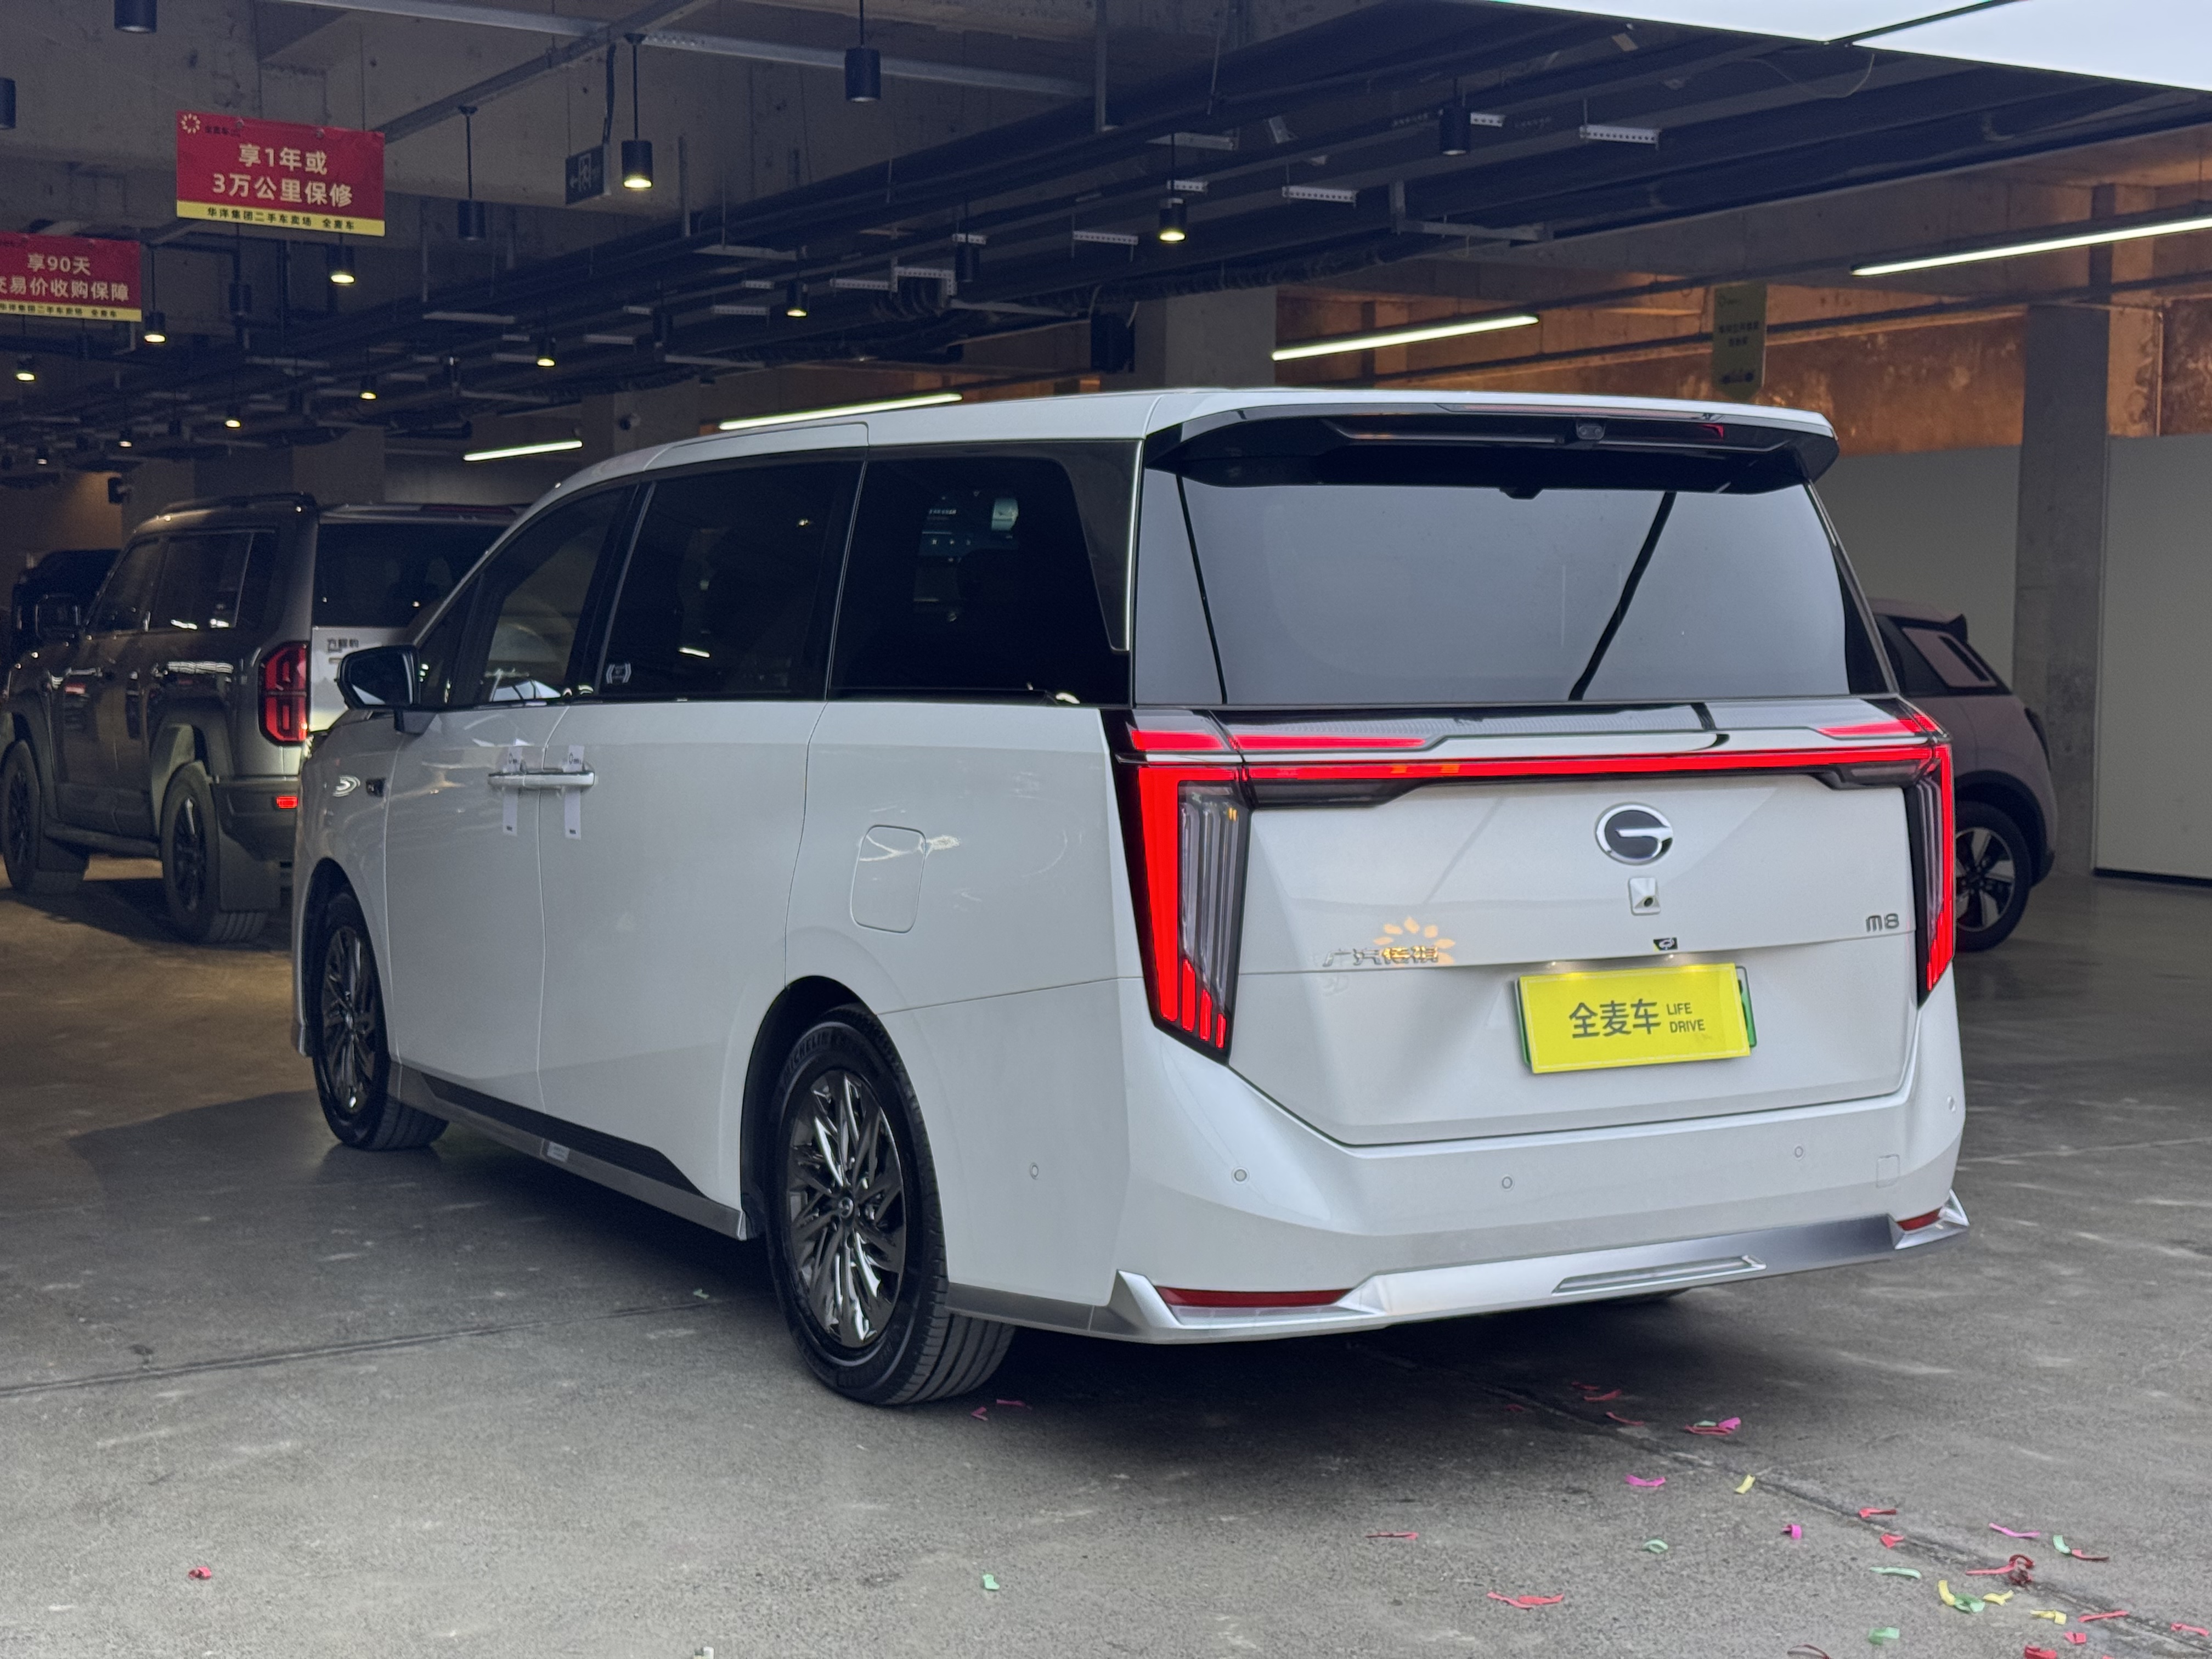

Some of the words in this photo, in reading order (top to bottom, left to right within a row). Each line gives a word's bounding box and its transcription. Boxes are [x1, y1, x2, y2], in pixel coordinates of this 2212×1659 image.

[239, 144, 328, 175] 享1年或
[212, 173, 353, 208] 3万公里保修
[28, 253, 91, 276] 享90天
[1569, 998, 1662, 1039] 全麦车
[1666, 1002, 1692, 1015] LIFE
[1669, 1019, 1706, 1034] DRIVE
